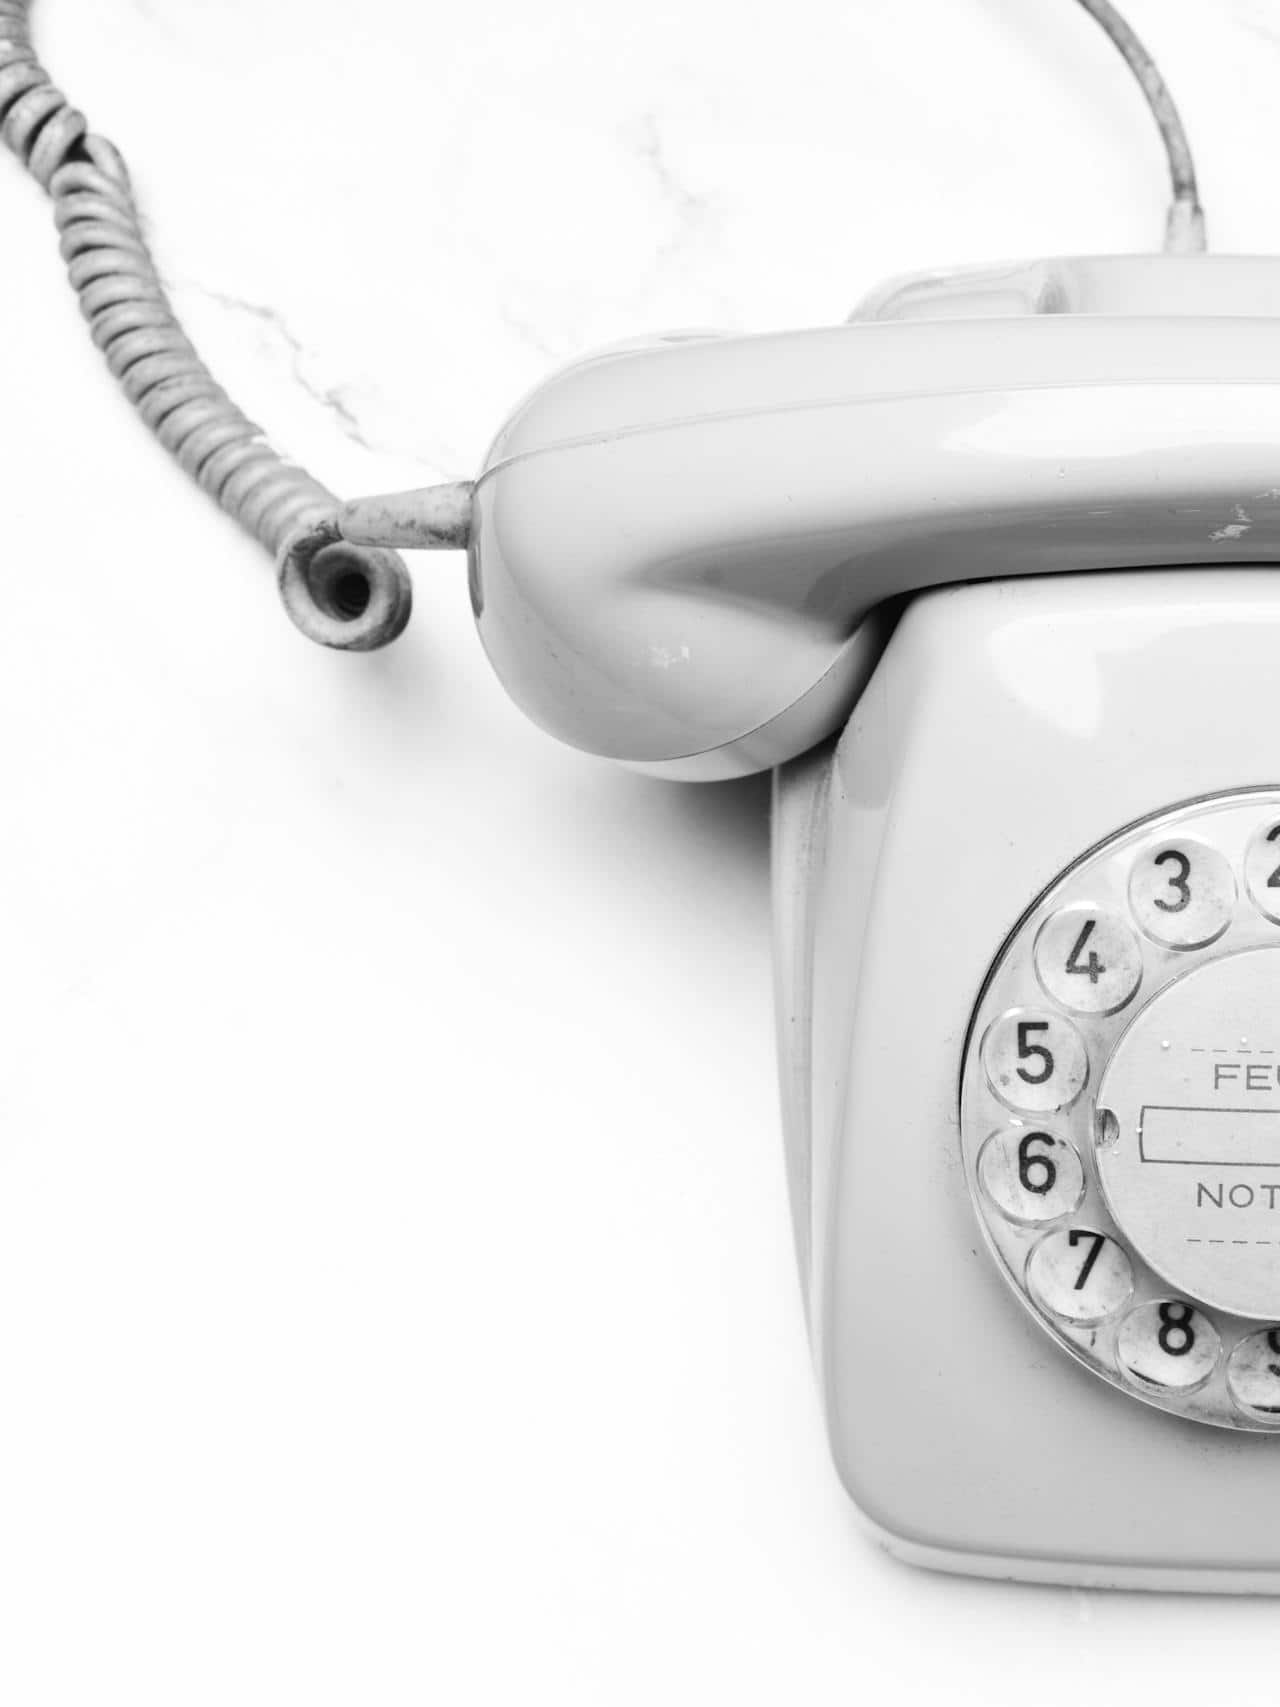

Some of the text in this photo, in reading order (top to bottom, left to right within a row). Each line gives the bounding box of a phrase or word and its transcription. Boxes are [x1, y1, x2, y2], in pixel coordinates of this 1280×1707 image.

[1153, 850, 1191, 913] 3
[1064, 919, 1106, 984] 4
[1015, 1021, 1055, 1084] 5
[1017, 1132, 1058, 1195] 6
[1068, 1230, 1106, 1290] 7
[1157, 1302, 1196, 1357] 8
